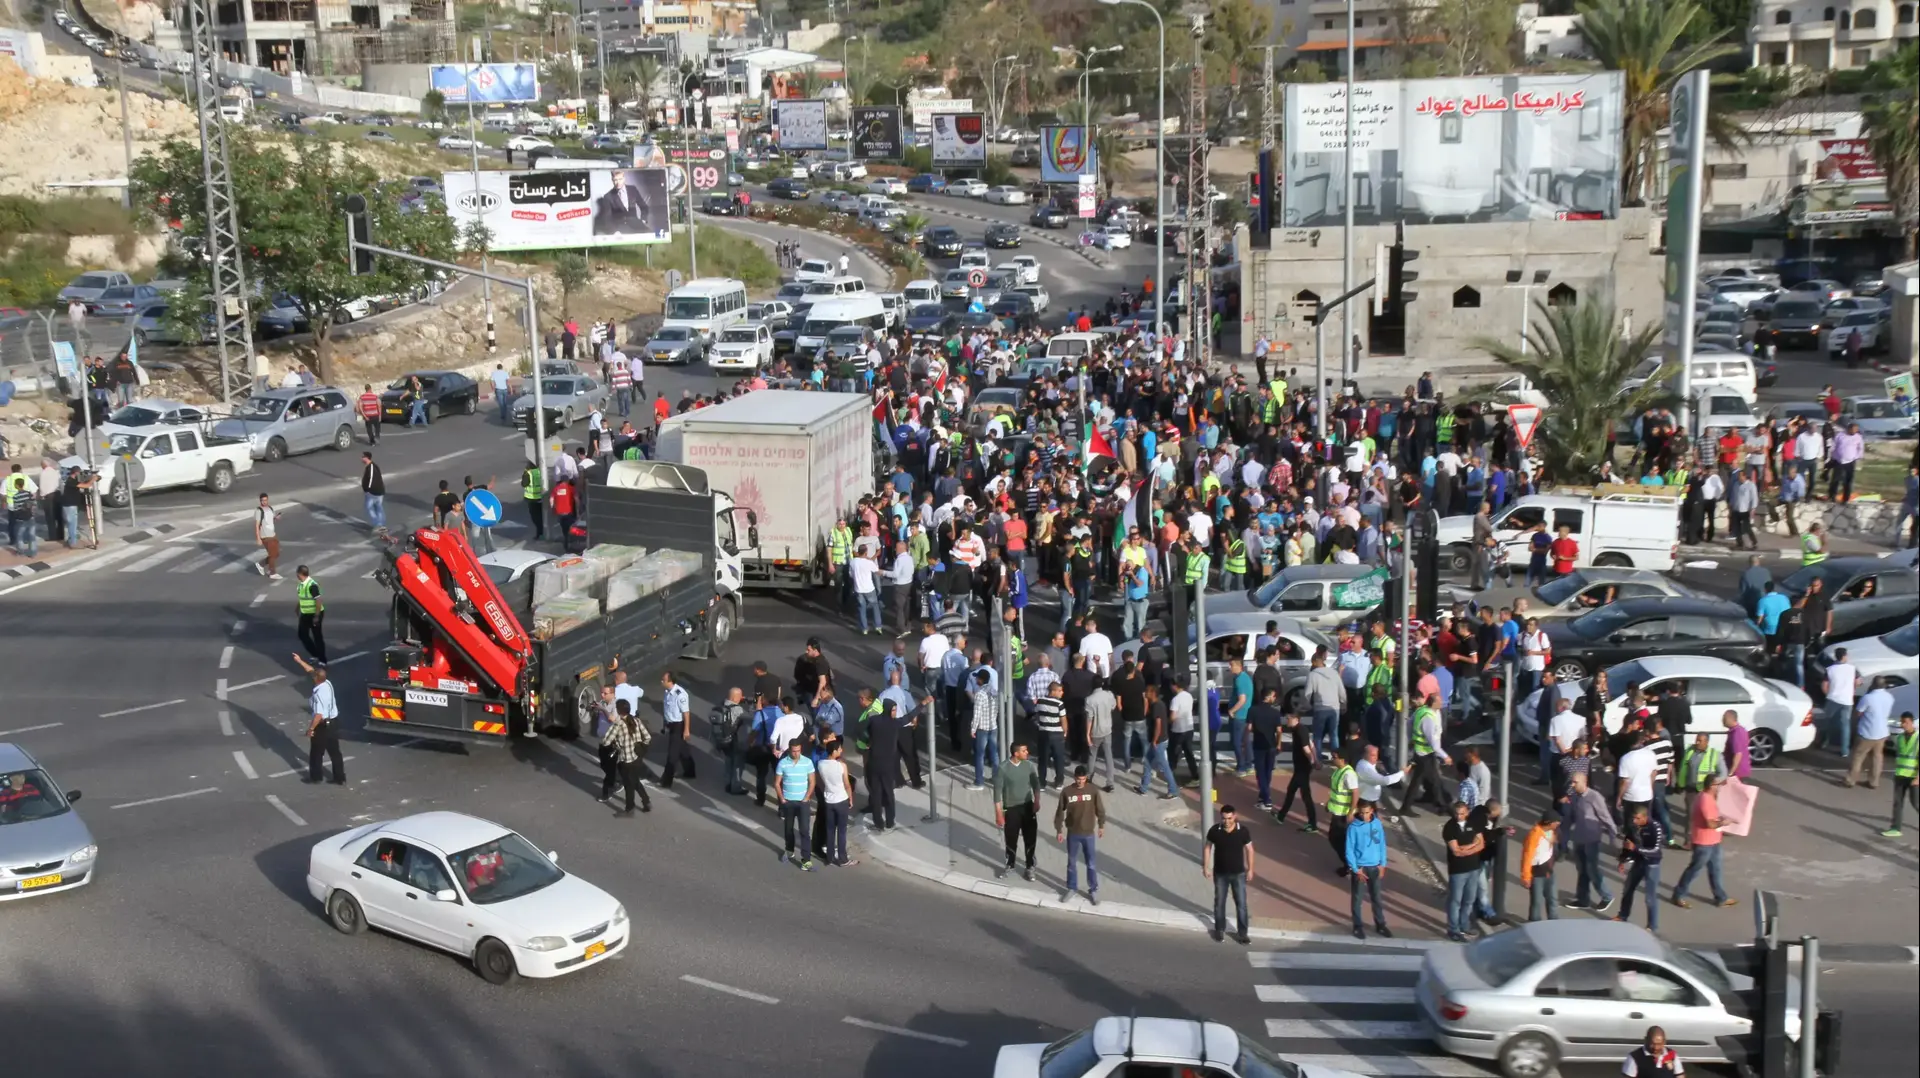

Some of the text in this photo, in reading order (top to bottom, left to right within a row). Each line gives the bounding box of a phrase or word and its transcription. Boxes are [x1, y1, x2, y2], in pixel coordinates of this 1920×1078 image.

[1351, 104, 1380, 114] كراميك
[1415, 91, 1585, 116] كراميكا صالح عواد
[693, 166, 719, 188] 99
[513, 182, 557, 199] عرسان
[461, 195, 494, 208] SOO
[689, 444, 732, 457] אלפחם
[737, 446, 760, 458] אום
[484, 602, 514, 640] FASSI
[408, 692, 447, 704] VOLVO
